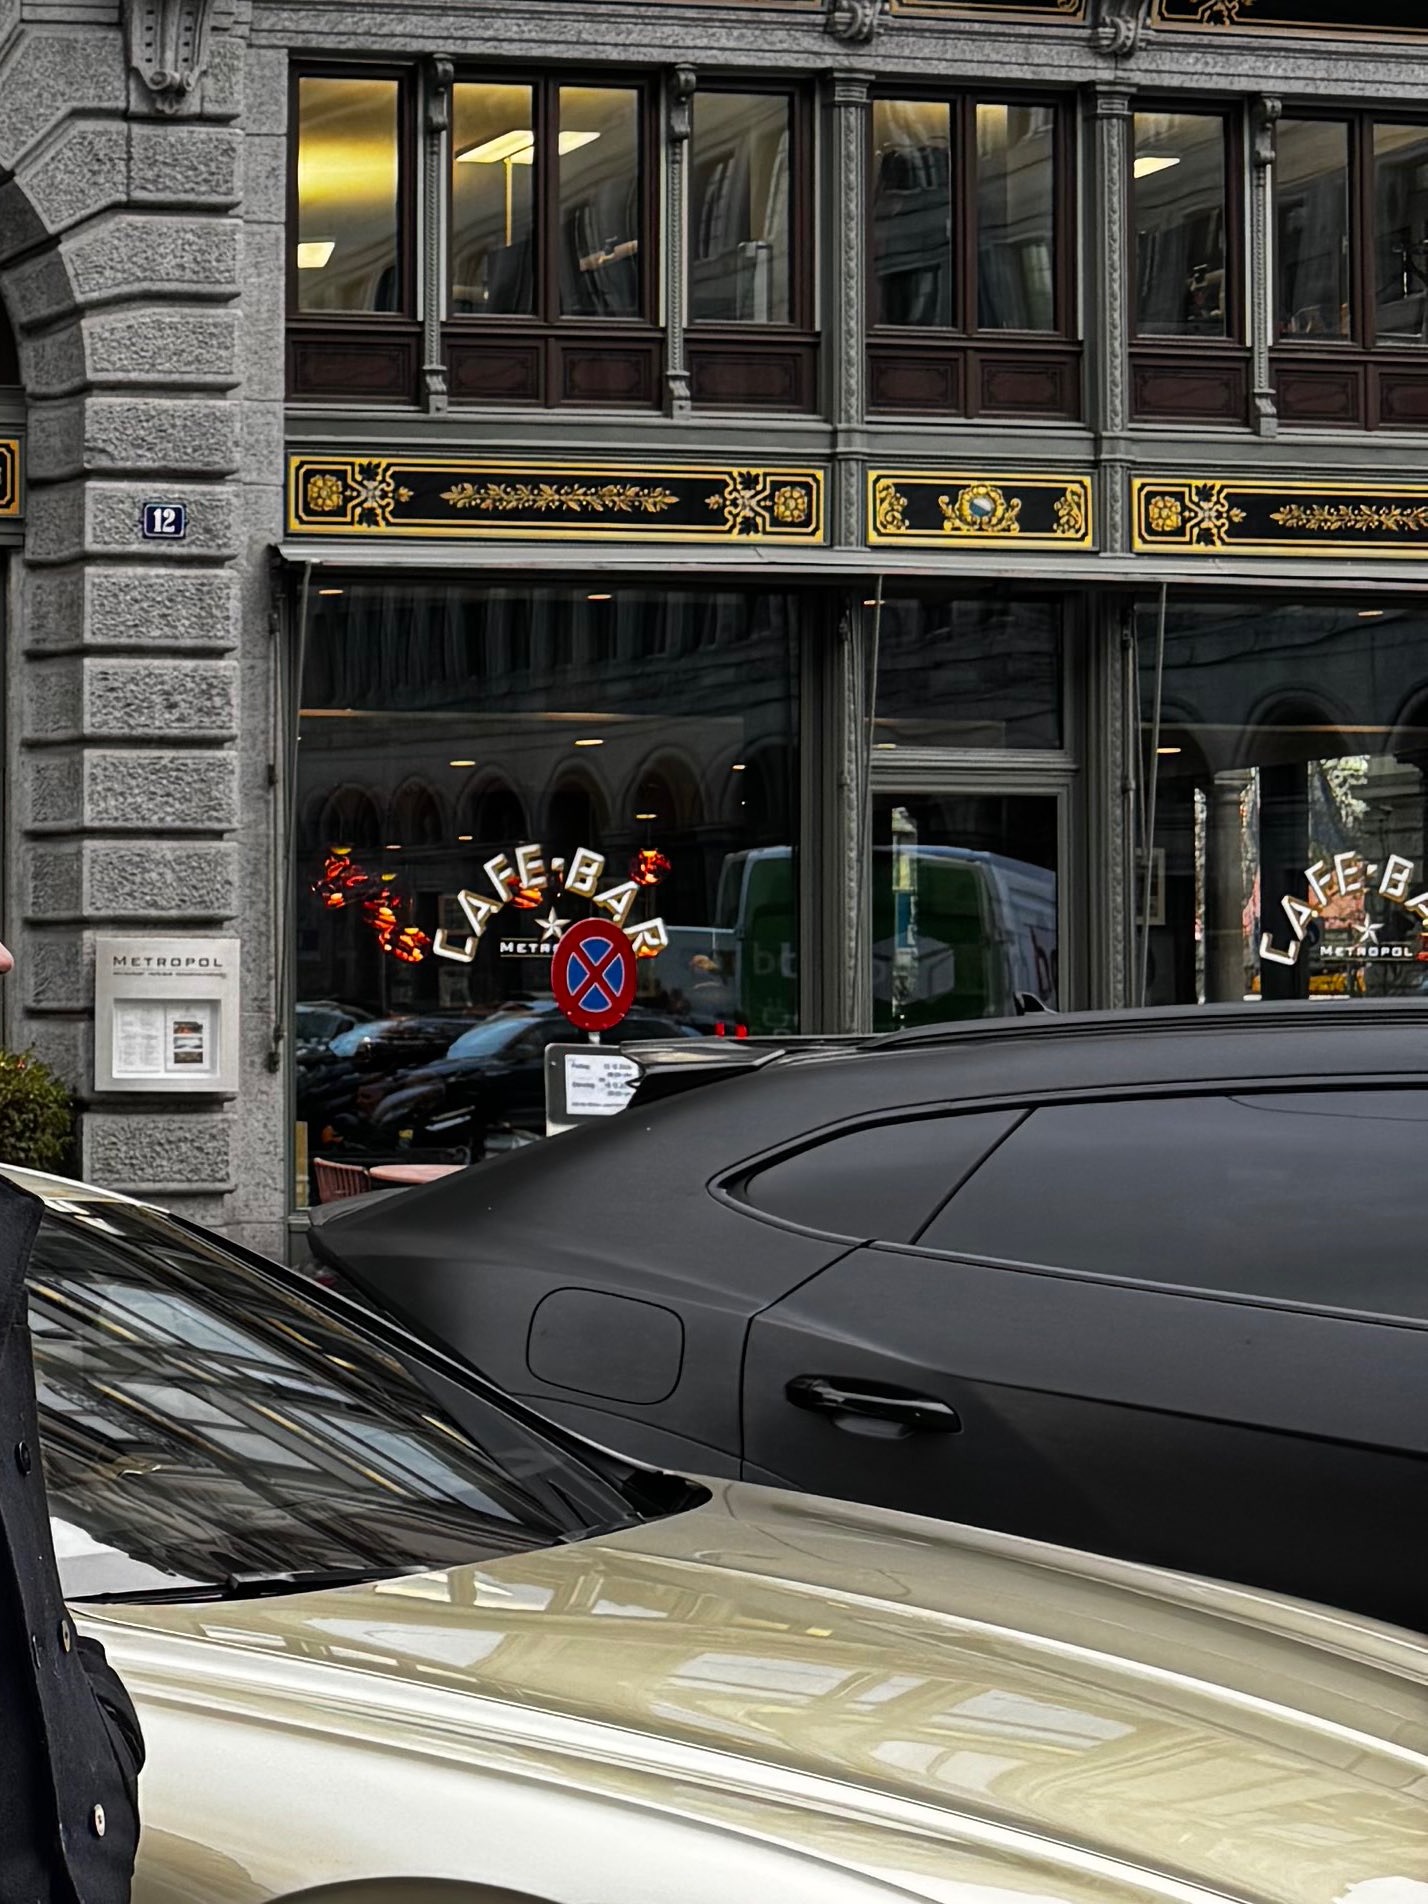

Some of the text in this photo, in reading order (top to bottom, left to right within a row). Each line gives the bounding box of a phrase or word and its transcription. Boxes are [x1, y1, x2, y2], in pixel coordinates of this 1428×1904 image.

[153, 508, 176, 533] 12
[1319, 946, 1413, 957] METROPOL
[113, 956, 223, 967] METROPOL
